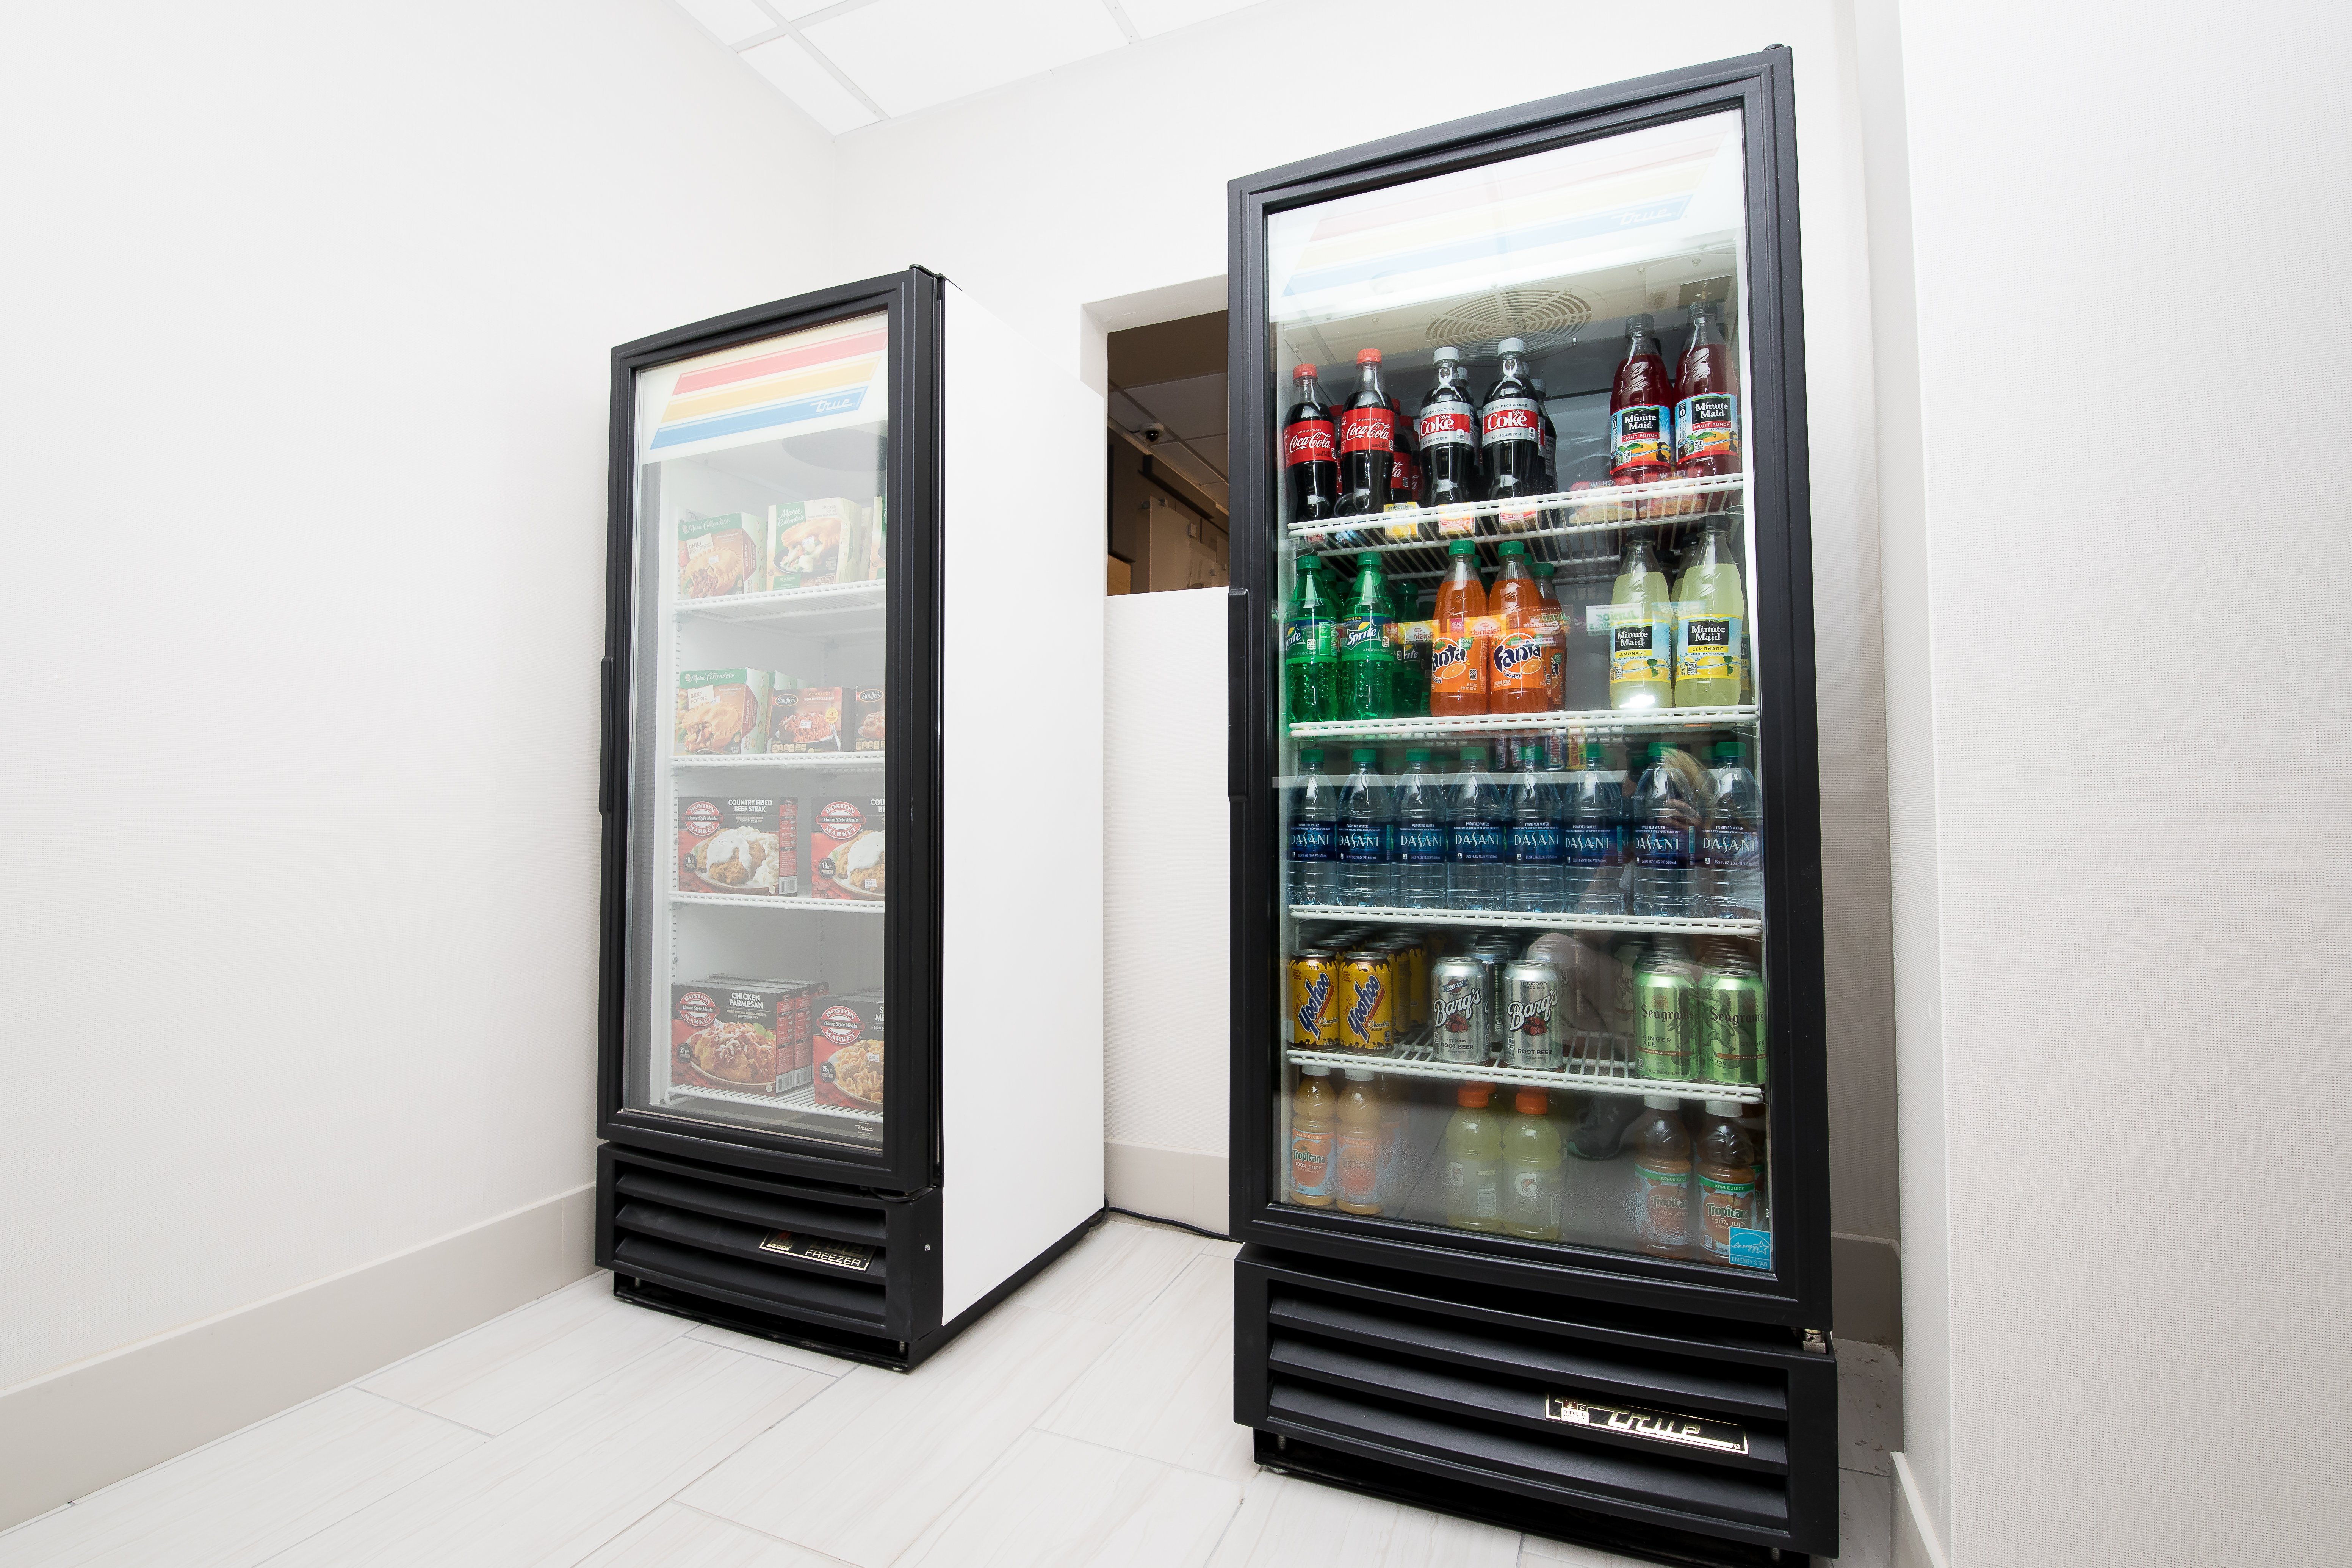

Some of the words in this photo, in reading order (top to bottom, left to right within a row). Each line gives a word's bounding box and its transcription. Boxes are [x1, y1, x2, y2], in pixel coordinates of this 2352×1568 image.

[1611, 208, 1671, 226] true
[810, 398, 855, 413] true
[1696, 402, 1729, 412] Minute
[1624, 414, 1657, 424] Minute
[1700, 409, 1724, 419] Maid
[1420, 417, 1455, 437] Coke
[1487, 412, 1527, 431] Coke
[1629, 420, 1652, 431] Maid
[1346, 422, 1391, 441] Coca-Cola
[1289, 432, 1331, 453] Coca-Cola
[778, 508, 802, 520] Marie
[703, 518, 731, 531] Callender's
[778, 515, 804, 527] Callender's
[688, 541, 702, 549] CHILI
[1617, 630, 1648, 640] Minute
[1691, 625, 1726, 634] Minute
[1286, 630, 1301, 652] prite
[1347, 628, 1377, 646] Sprite
[1620, 638, 1644, 647] Maid
[1695, 633, 1721, 641] Maid
[1404, 649, 1418, 660] rite
[1433, 644, 1466, 673] anta
[1494, 640, 1541, 673] Fanta
[689, 674, 705, 683] Marie
[706, 672, 734, 682] Callender's
[689, 803, 715, 813] BOSTON
[825, 803, 856, 814] BOSTON
[689, 824, 715, 834] MARKET
[825, 826, 856, 837] MARKET
[1291, 832, 1329, 847] DASANI
[1339, 833, 1379, 849] DASANI
[1401, 833, 1442, 849] DASANI
[1455, 831, 1498, 848] DASANI
[1514, 831, 1558, 849] DASANI
[1566, 834, 1609, 852] DASANI
[1635, 835, 1679, 853] DASANI
[1703, 835, 1755, 854] DASANI
[1446, 984, 1455, 992] 120
[684, 993, 711, 1004] BOSTON
[731, 992, 760, 1001] CHICKEN
[729, 998, 763, 1009] PARMESAN
[1434, 988, 1481, 1028] Barq's
[825, 1008, 856, 1020] BOSTON
[1508, 989, 1558, 1032] Barq's
[1641, 1003, 1694, 1023] Seagram's
[1710, 1007, 1765, 1026] Seagram's
[684, 1013, 712, 1024] MARKET
[825, 1030, 856, 1042] MARKET
[1643, 1035, 1671, 1043] GINGER
[1293, 1149, 1326, 1164] Tropicana
[1515, 1172, 1537, 1198] G
[1706, 1203, 1749, 1219] Tropicana
[1733, 1242, 1759, 1253] energy
[804, 1250, 861, 1267] FREEZER
